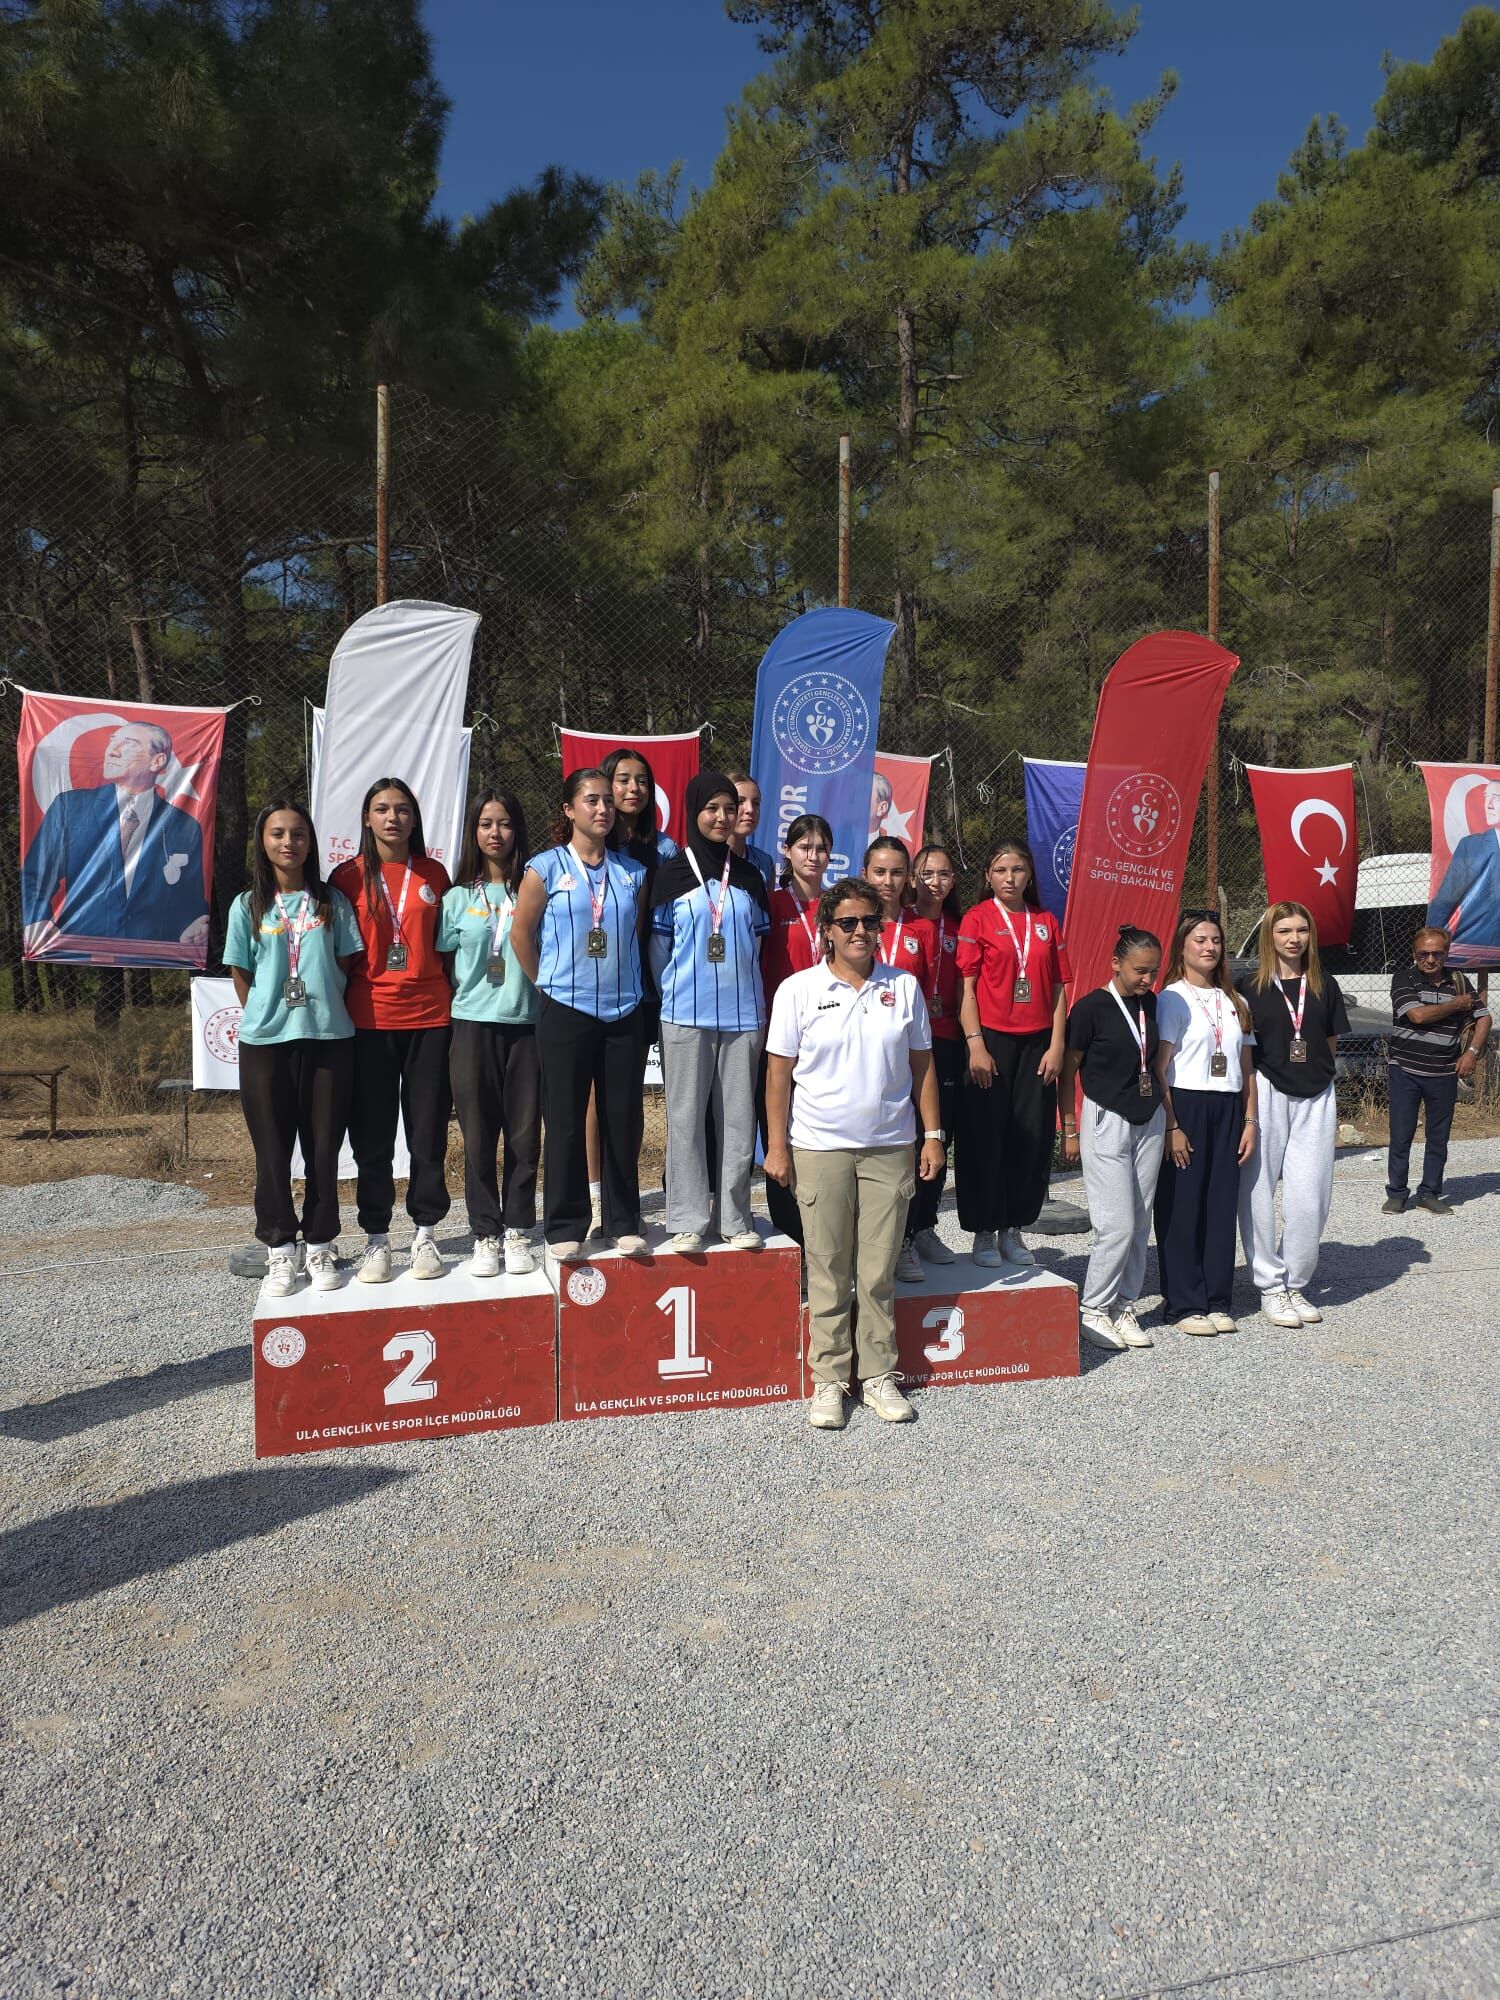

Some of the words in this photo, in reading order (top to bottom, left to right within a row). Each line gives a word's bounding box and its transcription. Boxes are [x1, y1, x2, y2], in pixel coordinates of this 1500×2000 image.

[330, 837, 355, 850] T.C.
[426, 847, 443, 859] VE
[1090, 869, 1118, 883] SPOR
[1120, 874, 1174, 893] BAKANLIĞI
[1095, 857, 1113, 869] T.C.
[1115, 861, 1159, 877] GENÇLİK
[1161, 869, 1174, 880] VE
[655, 1286, 712, 1380] 1
[922, 1306, 965, 1363] 3
[382, 1329, 438, 1406] 2
[930, 1371, 954, 1381] SPOR
[955, 1369, 975, 1380] İLÇE
[975, 1363, 1030, 1377] MÜDÜRLÜĞÜ
[575, 1402, 598, 1412] ULA
[599, 1395, 647, 1410] GENÇLİK
[649, 1395, 663, 1406] VE
[665, 1393, 694, 1404] SPOR
[696, 1391, 720, 1402] İLÇE
[721, 1384, 788, 1400] MÜDÜRLÜĞÜ
[296, 1429, 320, 1440] ULA
[322, 1422, 373, 1437] GENÇLİK
[374, 1421, 390, 1432] VE
[392, 1418, 423, 1430] SPOR
[424, 1414, 449, 1427] İLÇE
[451, 1405, 521, 1424] MÜDÜRLÜĞÜ
